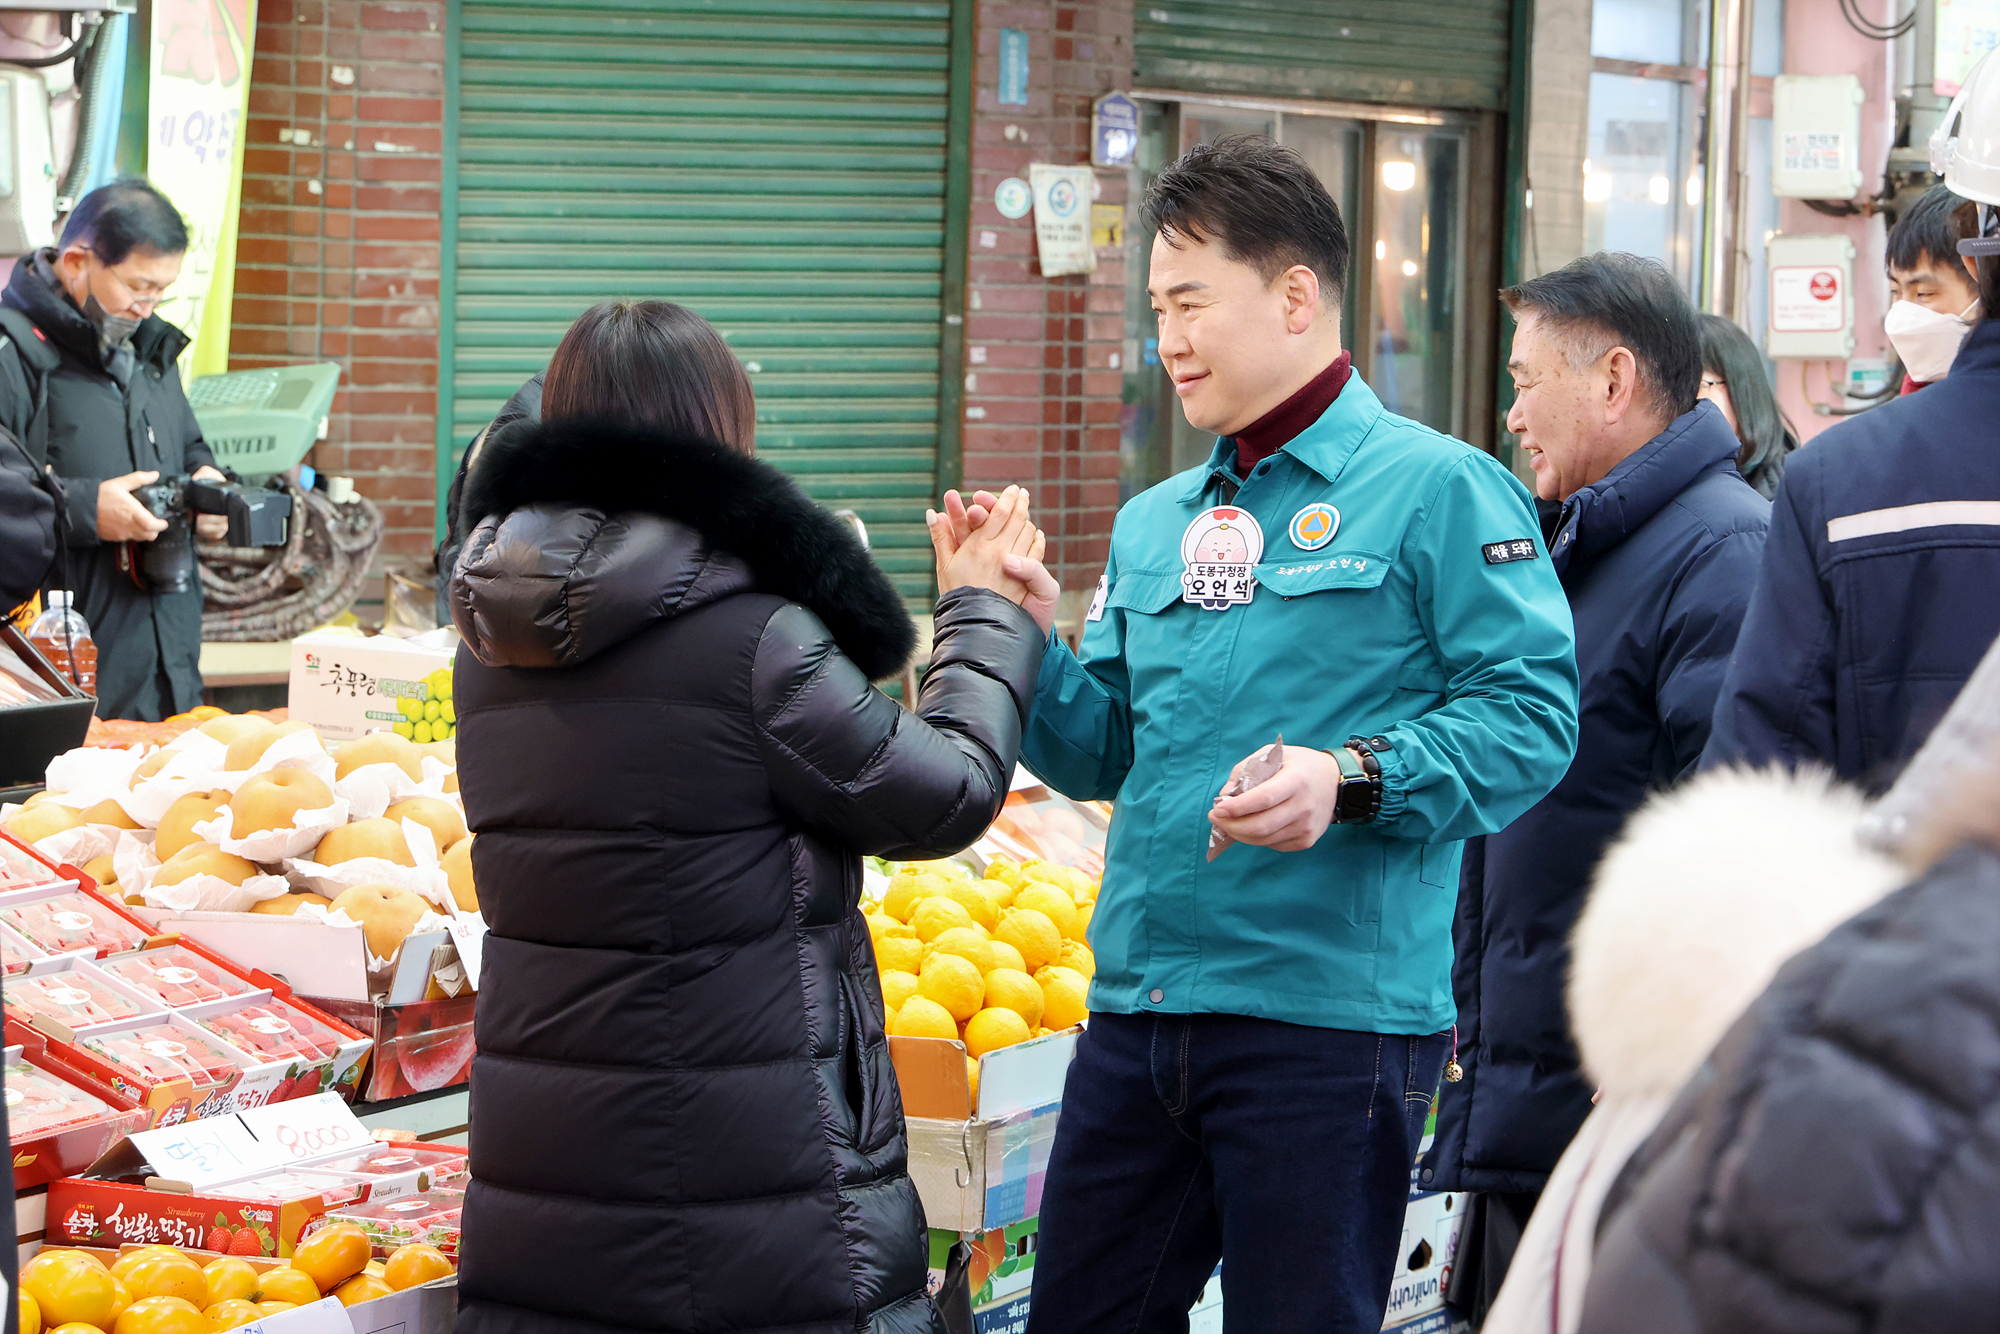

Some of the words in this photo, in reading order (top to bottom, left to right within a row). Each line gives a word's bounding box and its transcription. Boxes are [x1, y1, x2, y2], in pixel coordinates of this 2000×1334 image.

[1490, 543, 1509, 560] 서울
[1511, 540, 1533, 556] 도봉구
[1196, 565, 1247, 578] 도봉구청장
[320, 663, 376, 697] 추풍령
[241, 1074, 270, 1086] Strawberry
[237, 1089, 269, 1111] 딸기
[164, 1130, 244, 1172] 딸기
[373, 1185, 402, 1199] Strawberry
[165, 1205, 206, 1222] Strawberry
[63, 1209, 99, 1236] 순창
[105, 1202, 160, 1244] 행복한
[159, 1217, 204, 1248] 딸기
[1388, 1277, 1438, 1313] unifrutti
